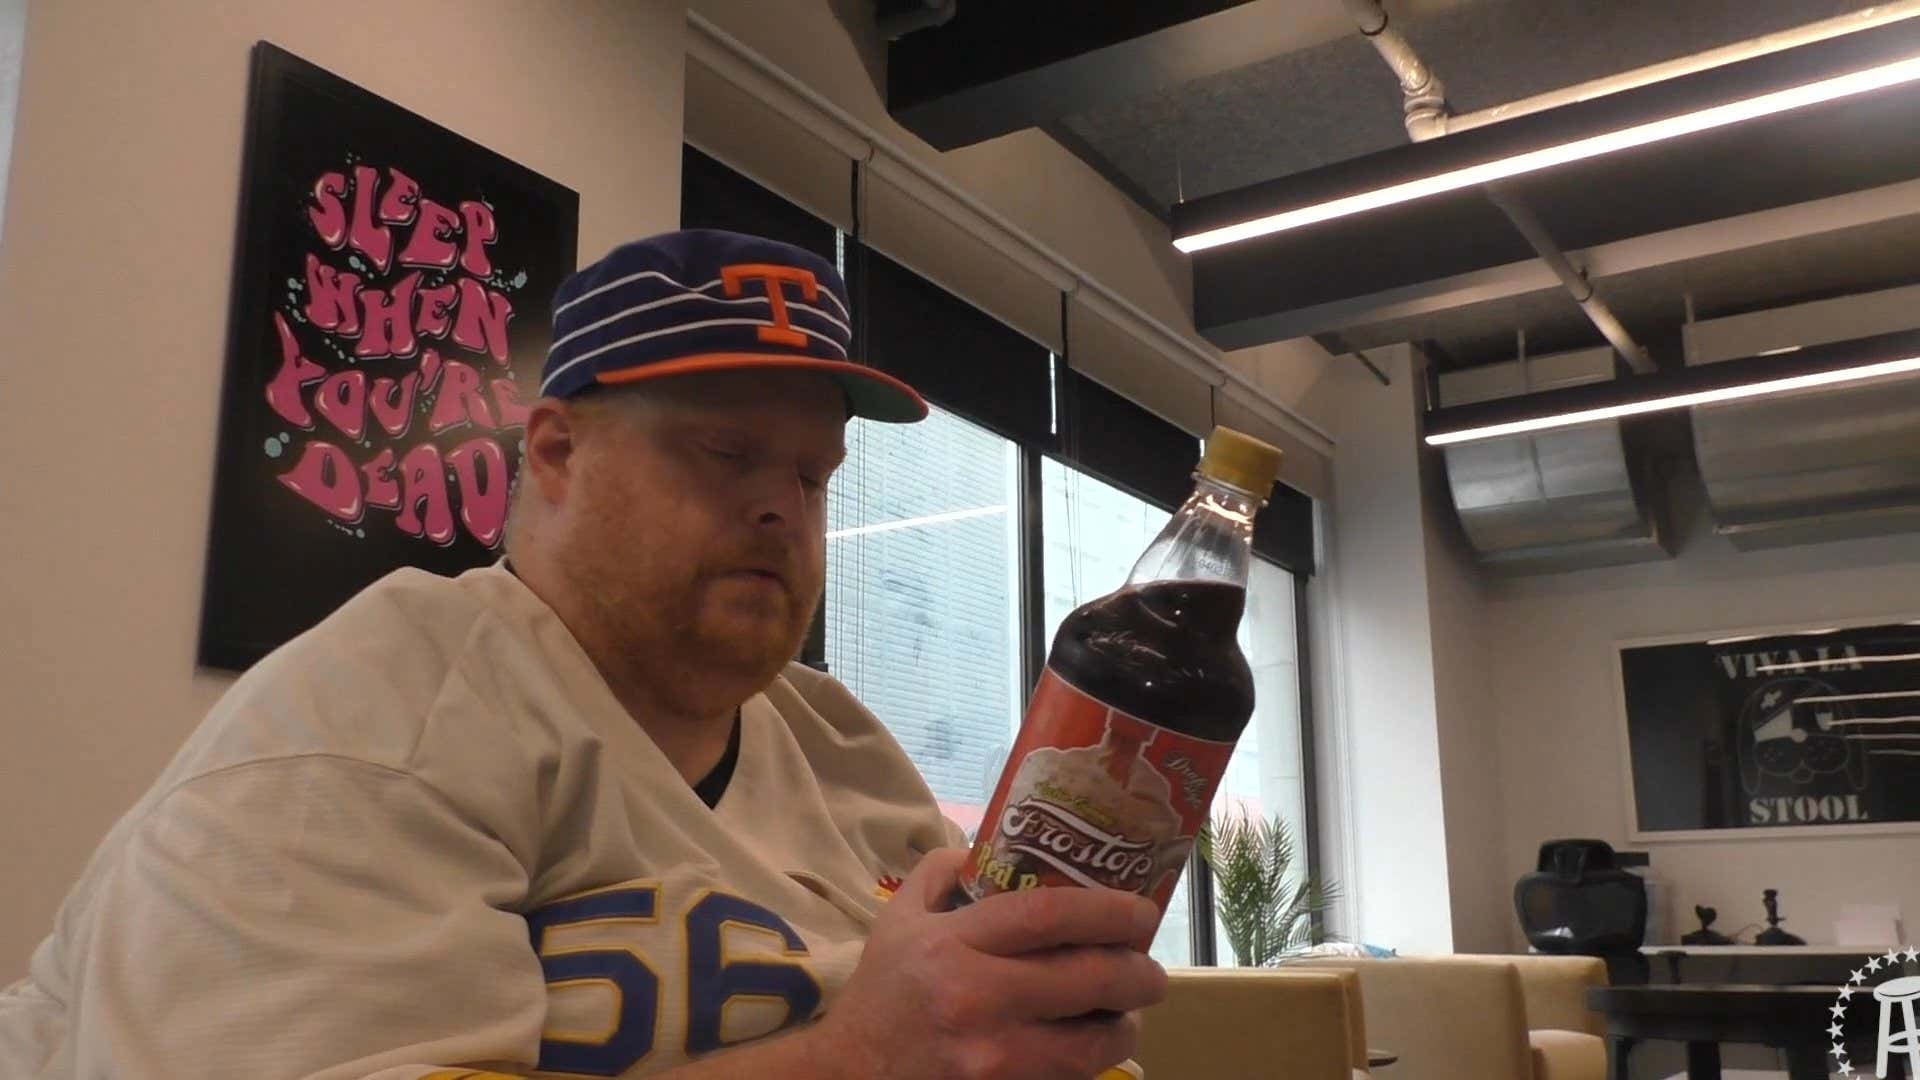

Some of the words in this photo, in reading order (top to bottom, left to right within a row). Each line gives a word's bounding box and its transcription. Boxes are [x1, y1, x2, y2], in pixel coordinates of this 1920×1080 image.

[310, 165, 498, 279] SLEEP
[305, 253, 513, 367] WHEN
[720, 264, 819, 348] T
[276, 438, 509, 549] DEAD
[1721, 650, 1805, 679] VIVA
[1815, 645, 1863, 672] LA
[1003, 801, 1152, 879] Frostop
[1749, 795, 1868, 823] STOOL
[525, 878, 824, 1076] 56
